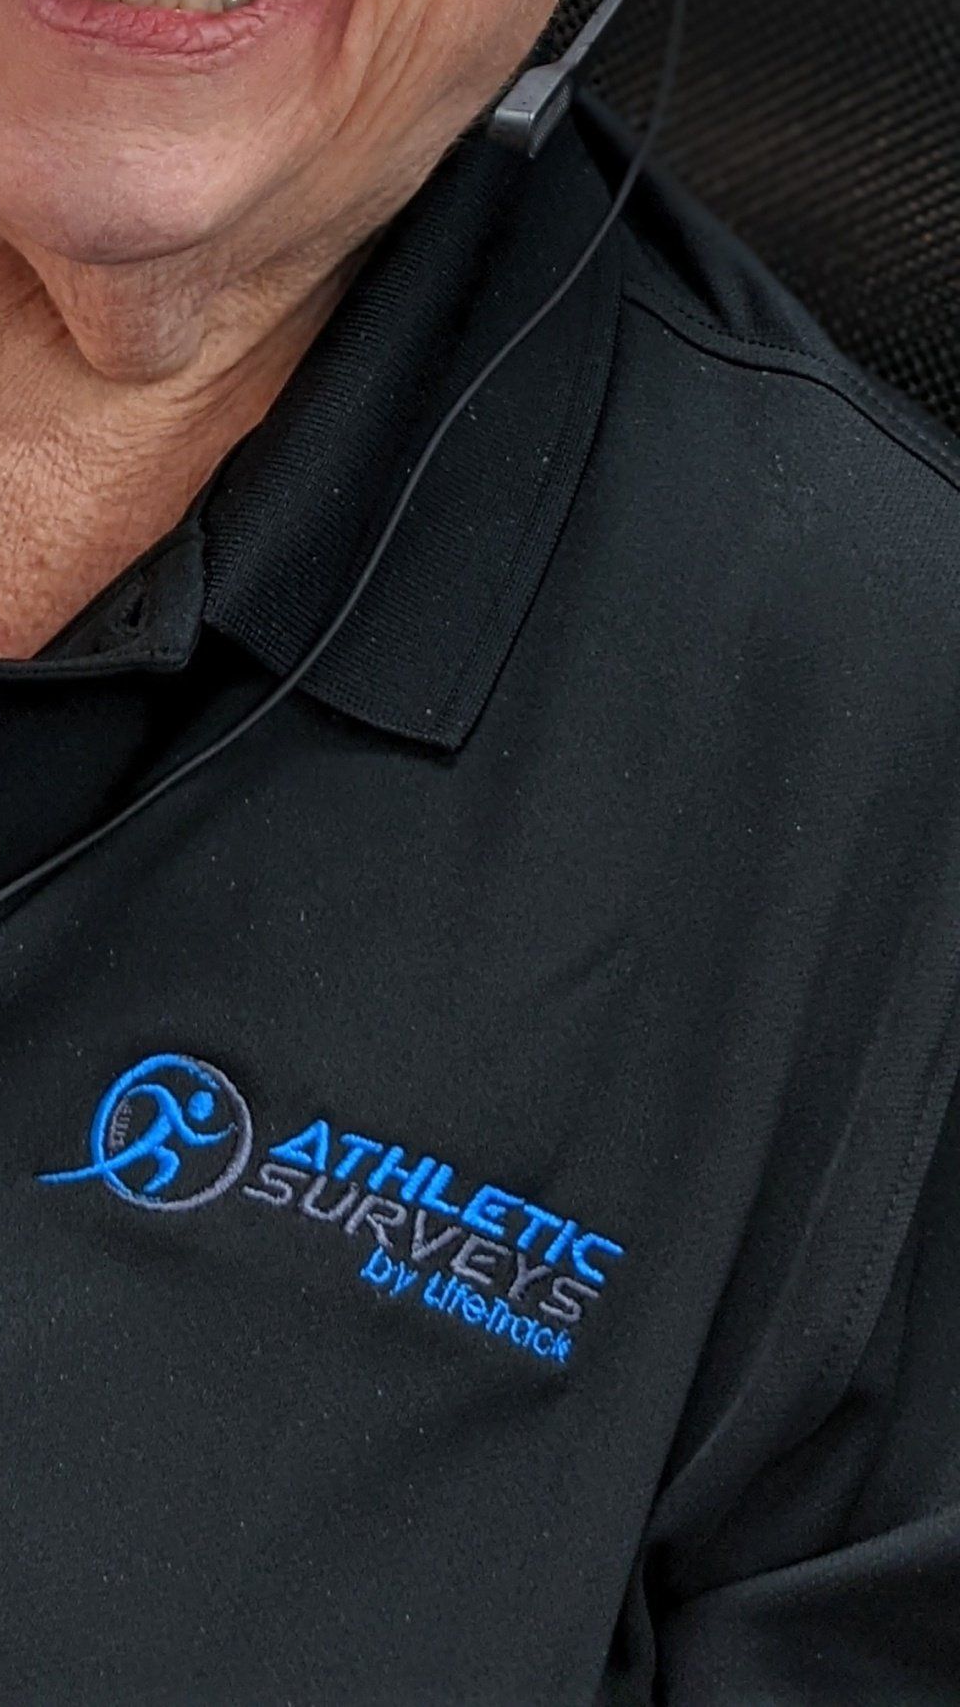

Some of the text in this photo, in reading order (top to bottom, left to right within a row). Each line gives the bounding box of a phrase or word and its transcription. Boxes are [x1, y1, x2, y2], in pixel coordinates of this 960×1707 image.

[244, 1162, 600, 1324] SURVEYS
[269, 1119, 625, 1284] ATHLETIC
[359, 1245, 419, 1297] by
